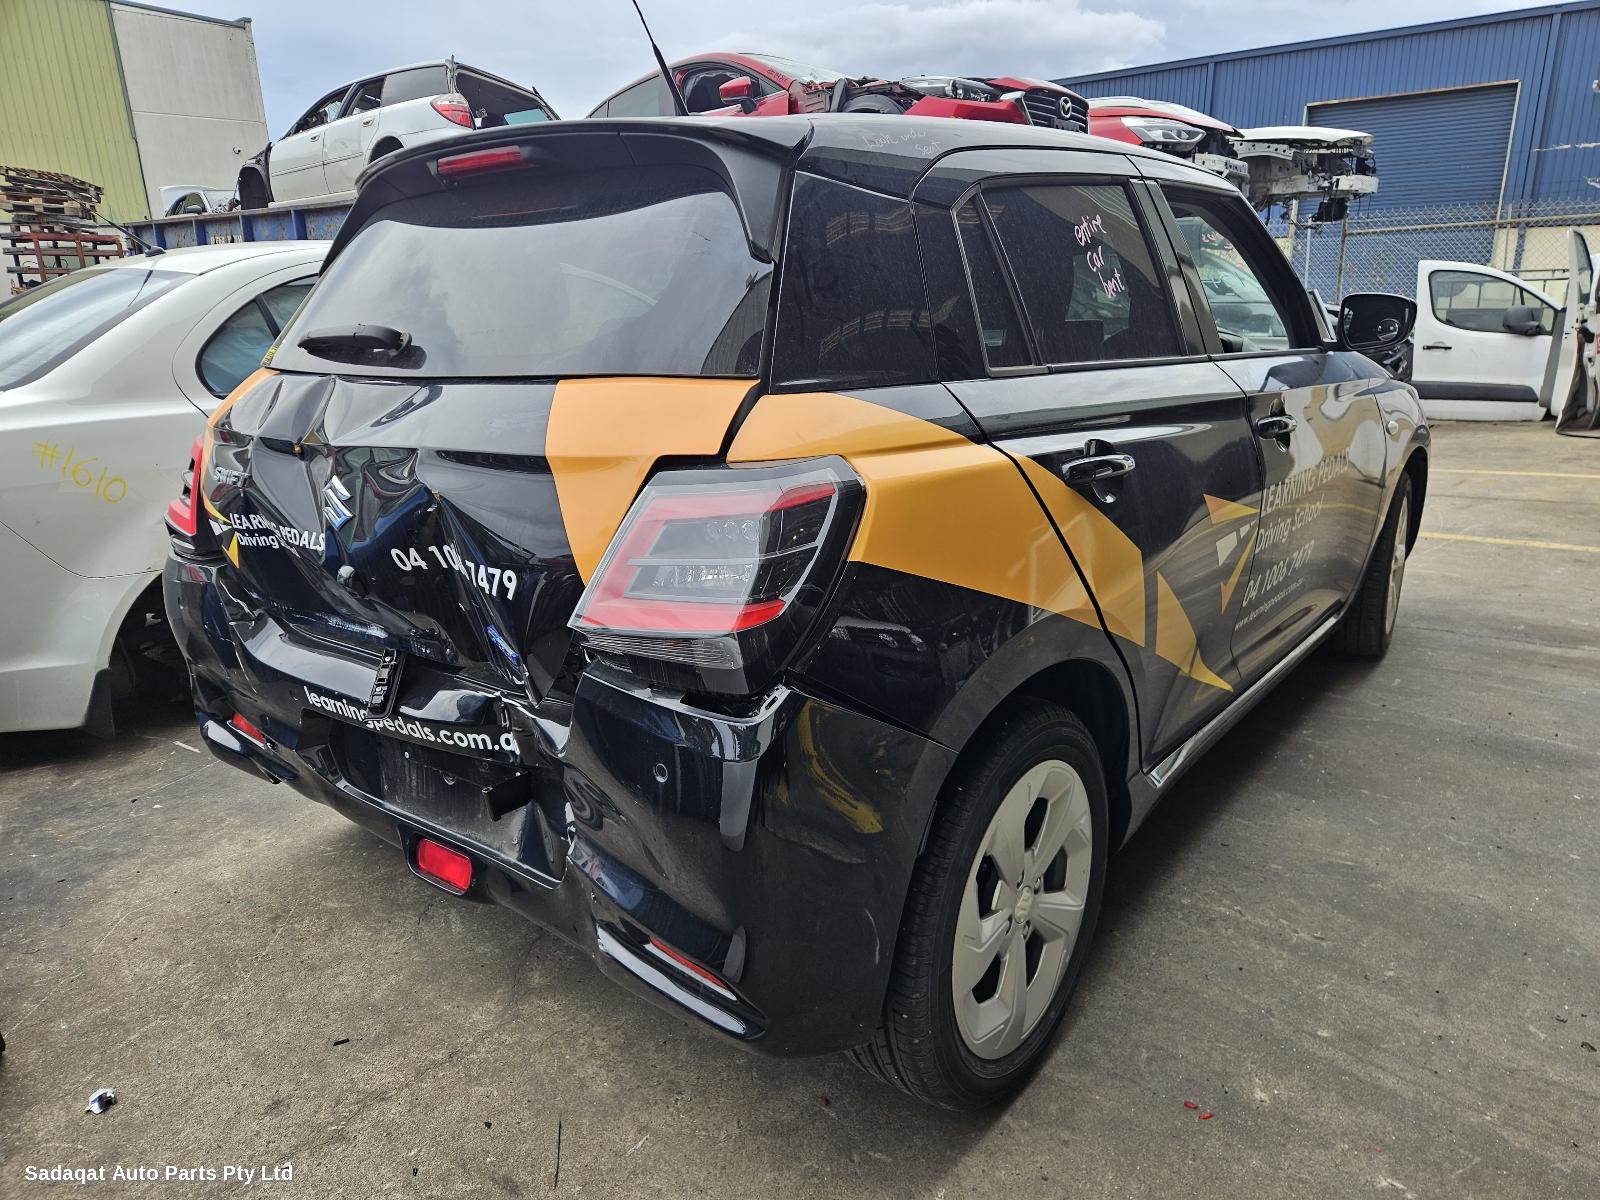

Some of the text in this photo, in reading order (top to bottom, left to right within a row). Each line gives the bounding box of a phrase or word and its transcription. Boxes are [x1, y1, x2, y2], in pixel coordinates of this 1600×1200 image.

[1260, 448, 1349, 518] LEARNING PEDALS
[236, 532, 280, 549] Driving
[279, 525, 326, 551] PEDALS
[1254, 492, 1325, 555] Driving School
[390, 540, 518, 601] 04 10 7479
